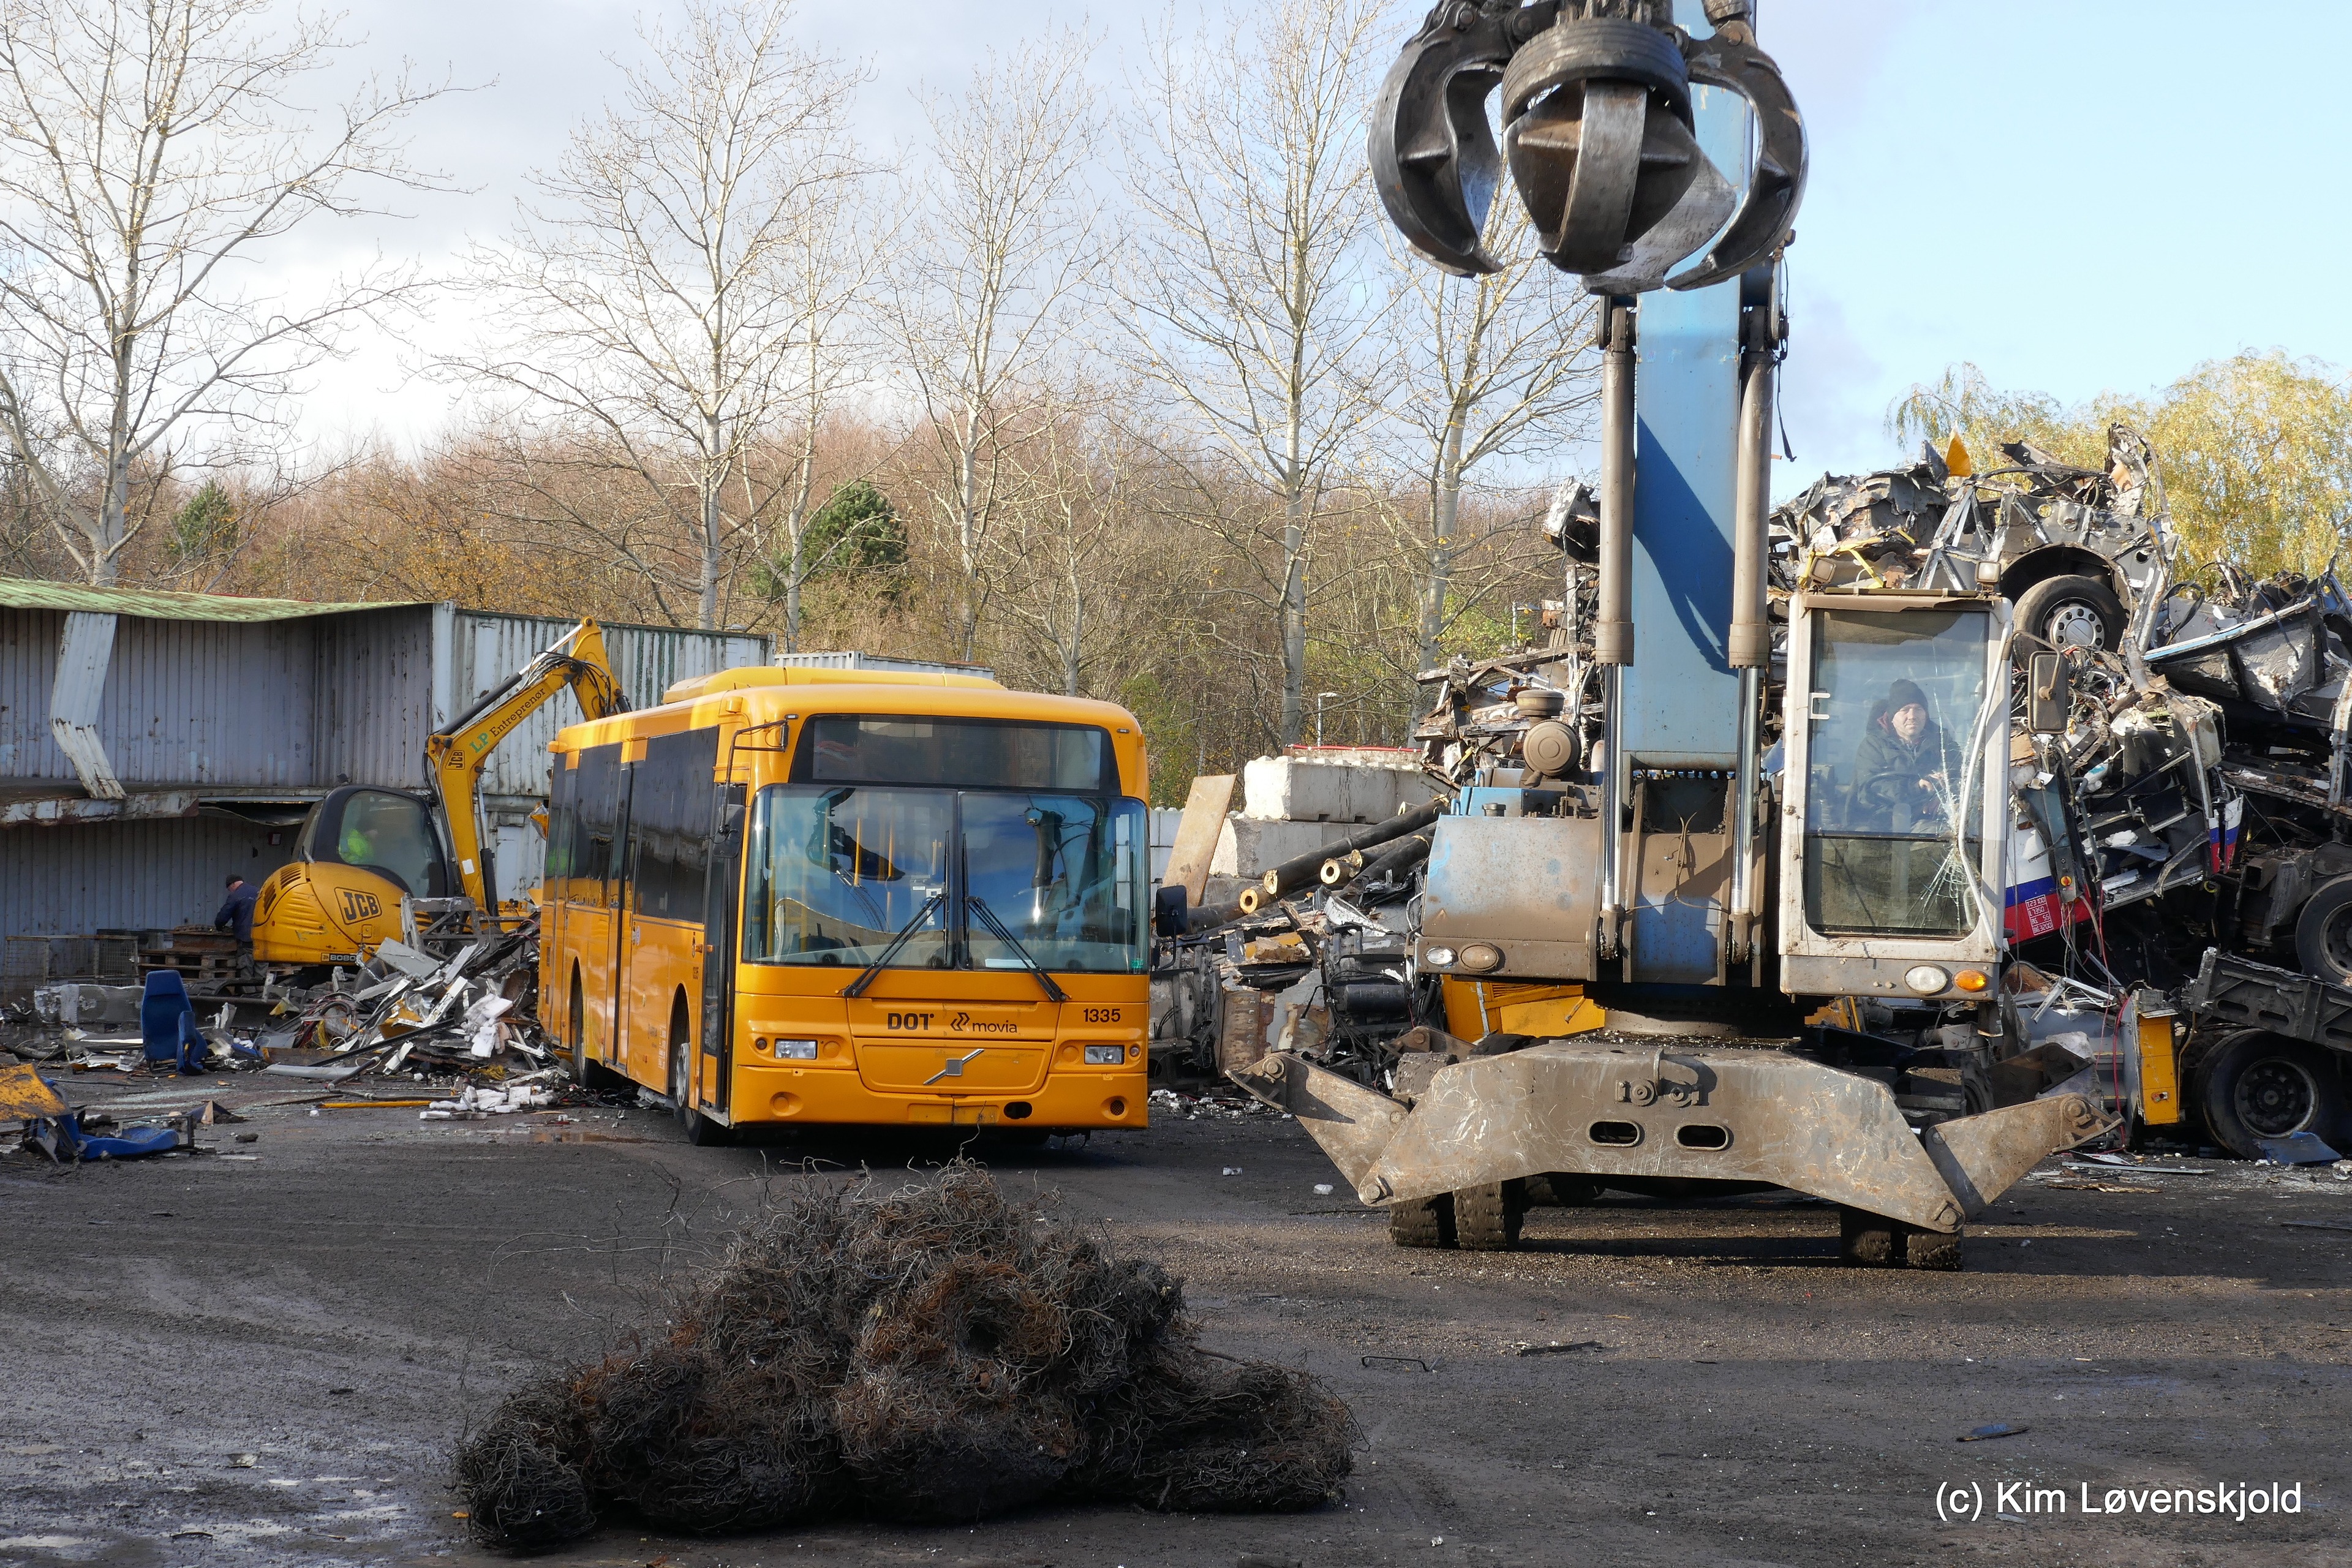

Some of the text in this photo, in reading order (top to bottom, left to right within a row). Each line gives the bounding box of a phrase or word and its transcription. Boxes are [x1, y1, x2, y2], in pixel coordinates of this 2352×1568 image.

[470, 688, 546, 753] LP Entreprenør
[448, 752, 463, 768] JCB
[344, 891, 379, 921] JCB
[888, 1012, 929, 1030] DOT
[1084, 1008, 1121, 1022] 1335
[972, 1020, 1017, 1033] movia
